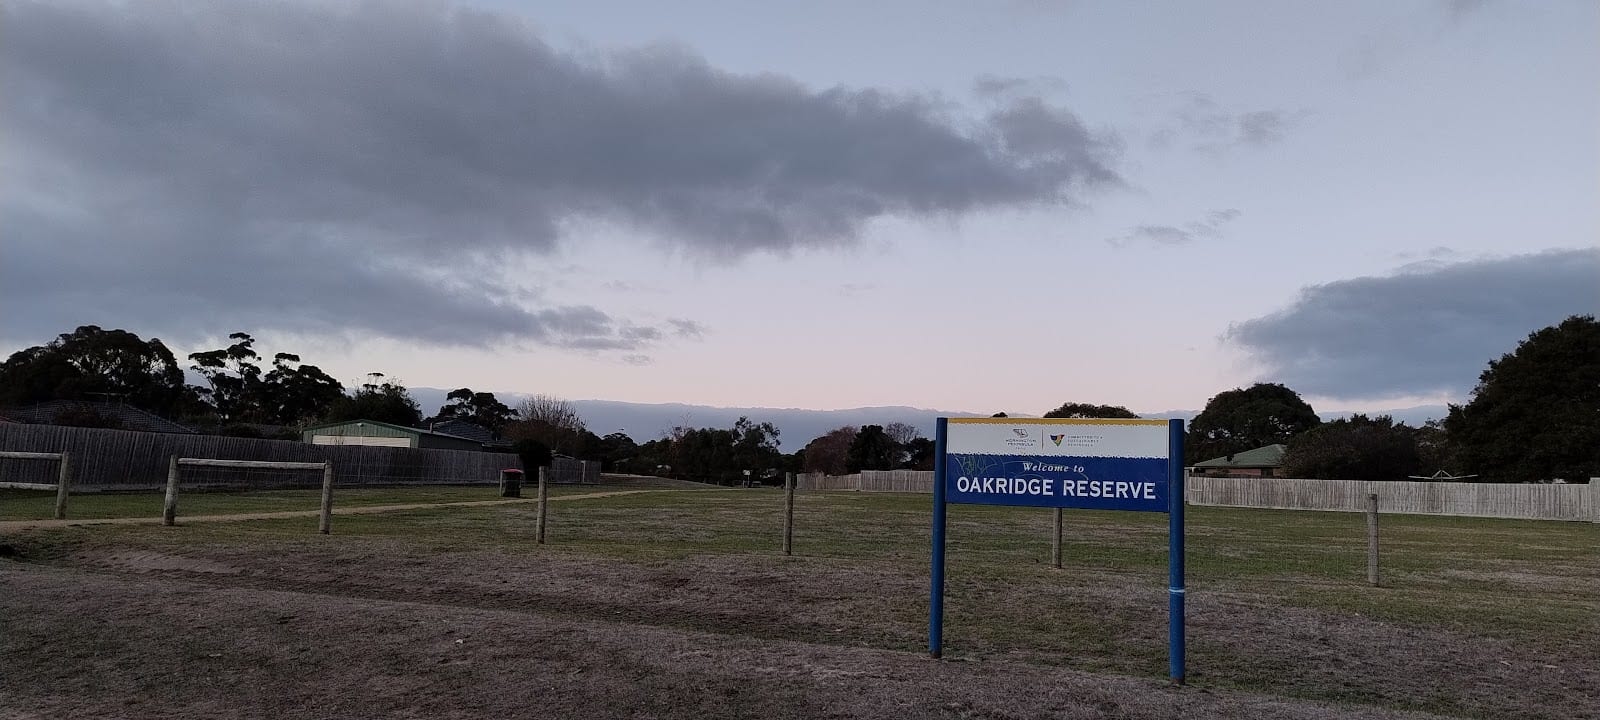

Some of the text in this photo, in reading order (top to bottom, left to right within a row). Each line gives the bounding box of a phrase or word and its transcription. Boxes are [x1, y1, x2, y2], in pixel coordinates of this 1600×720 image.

[1022, 462, 1085, 473] Welcome to
[956, 476, 1156, 500] OAKRIDGE RESERVE
